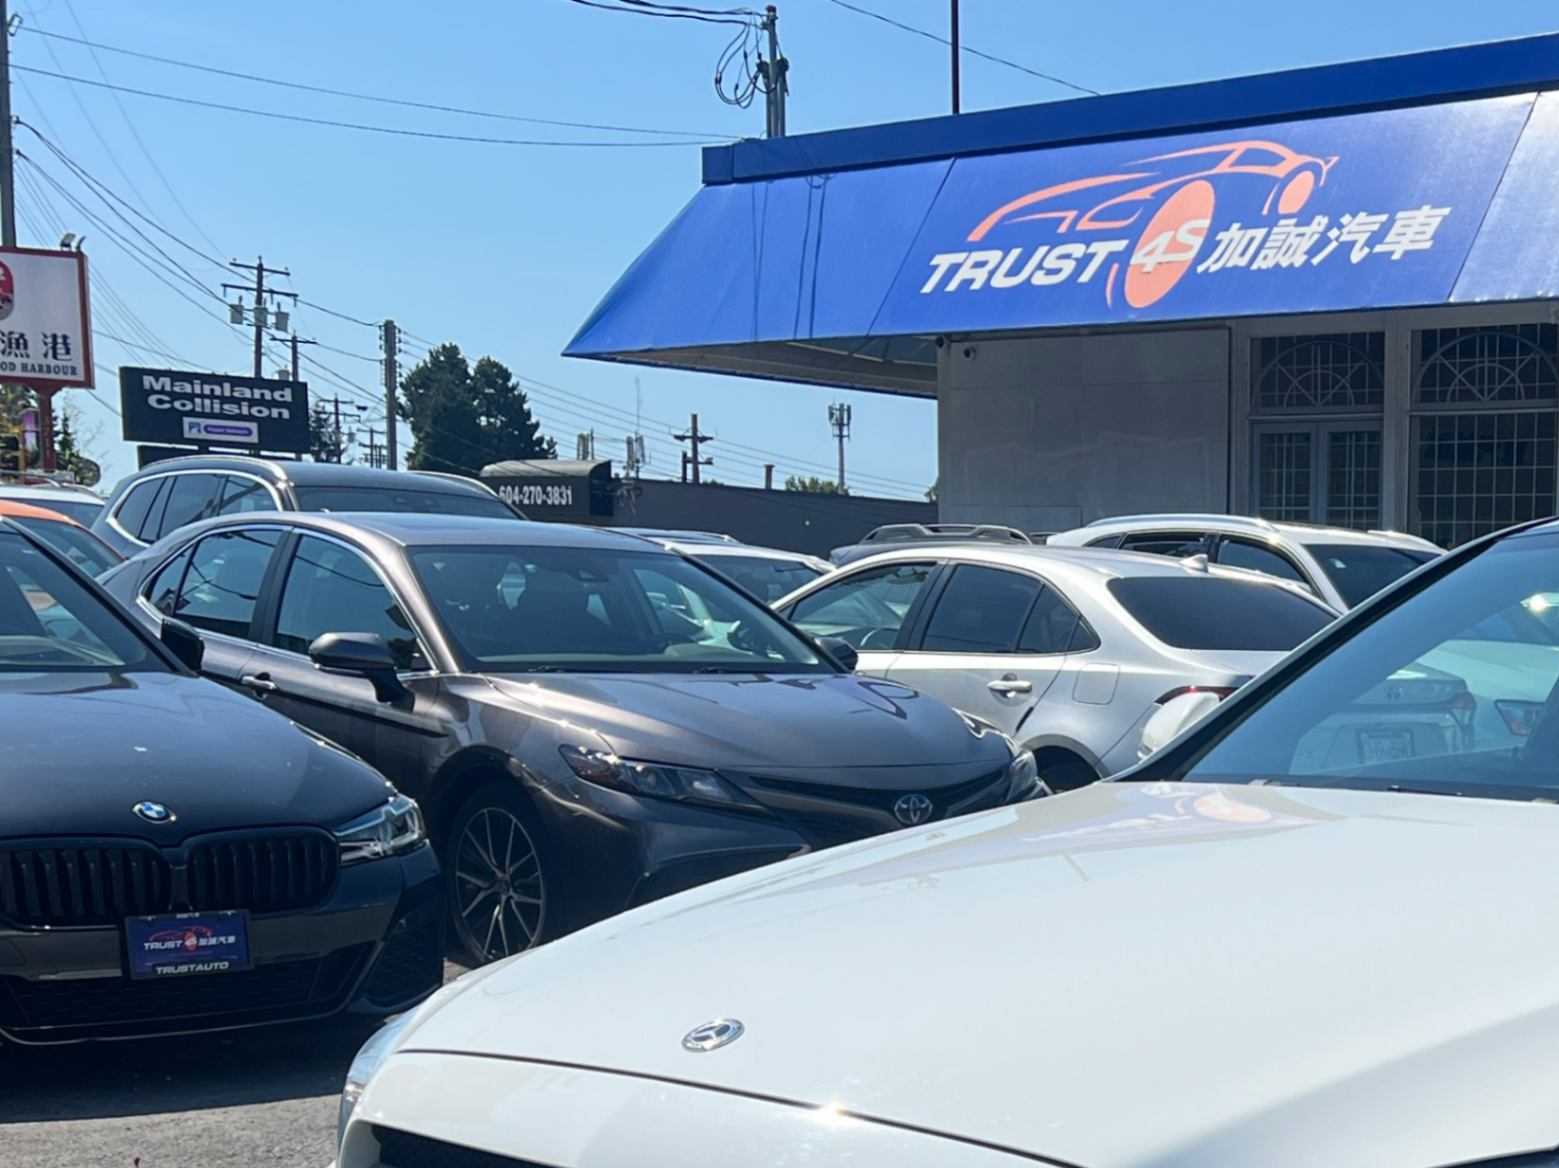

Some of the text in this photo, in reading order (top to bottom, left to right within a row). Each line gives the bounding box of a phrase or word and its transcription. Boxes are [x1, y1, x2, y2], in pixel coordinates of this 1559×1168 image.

[920, 204, 1452, 294] TRUST 4S 加誠汽車
[20, 361, 78, 376] HARBOUR
[142, 375, 293, 402] Mainland
[147, 394, 291, 419] Collision
[499, 486, 572, 505] 604-270-3831
[144, 939, 183, 951] TRUST
[155, 961, 230, 975] TRUSTAUTO
